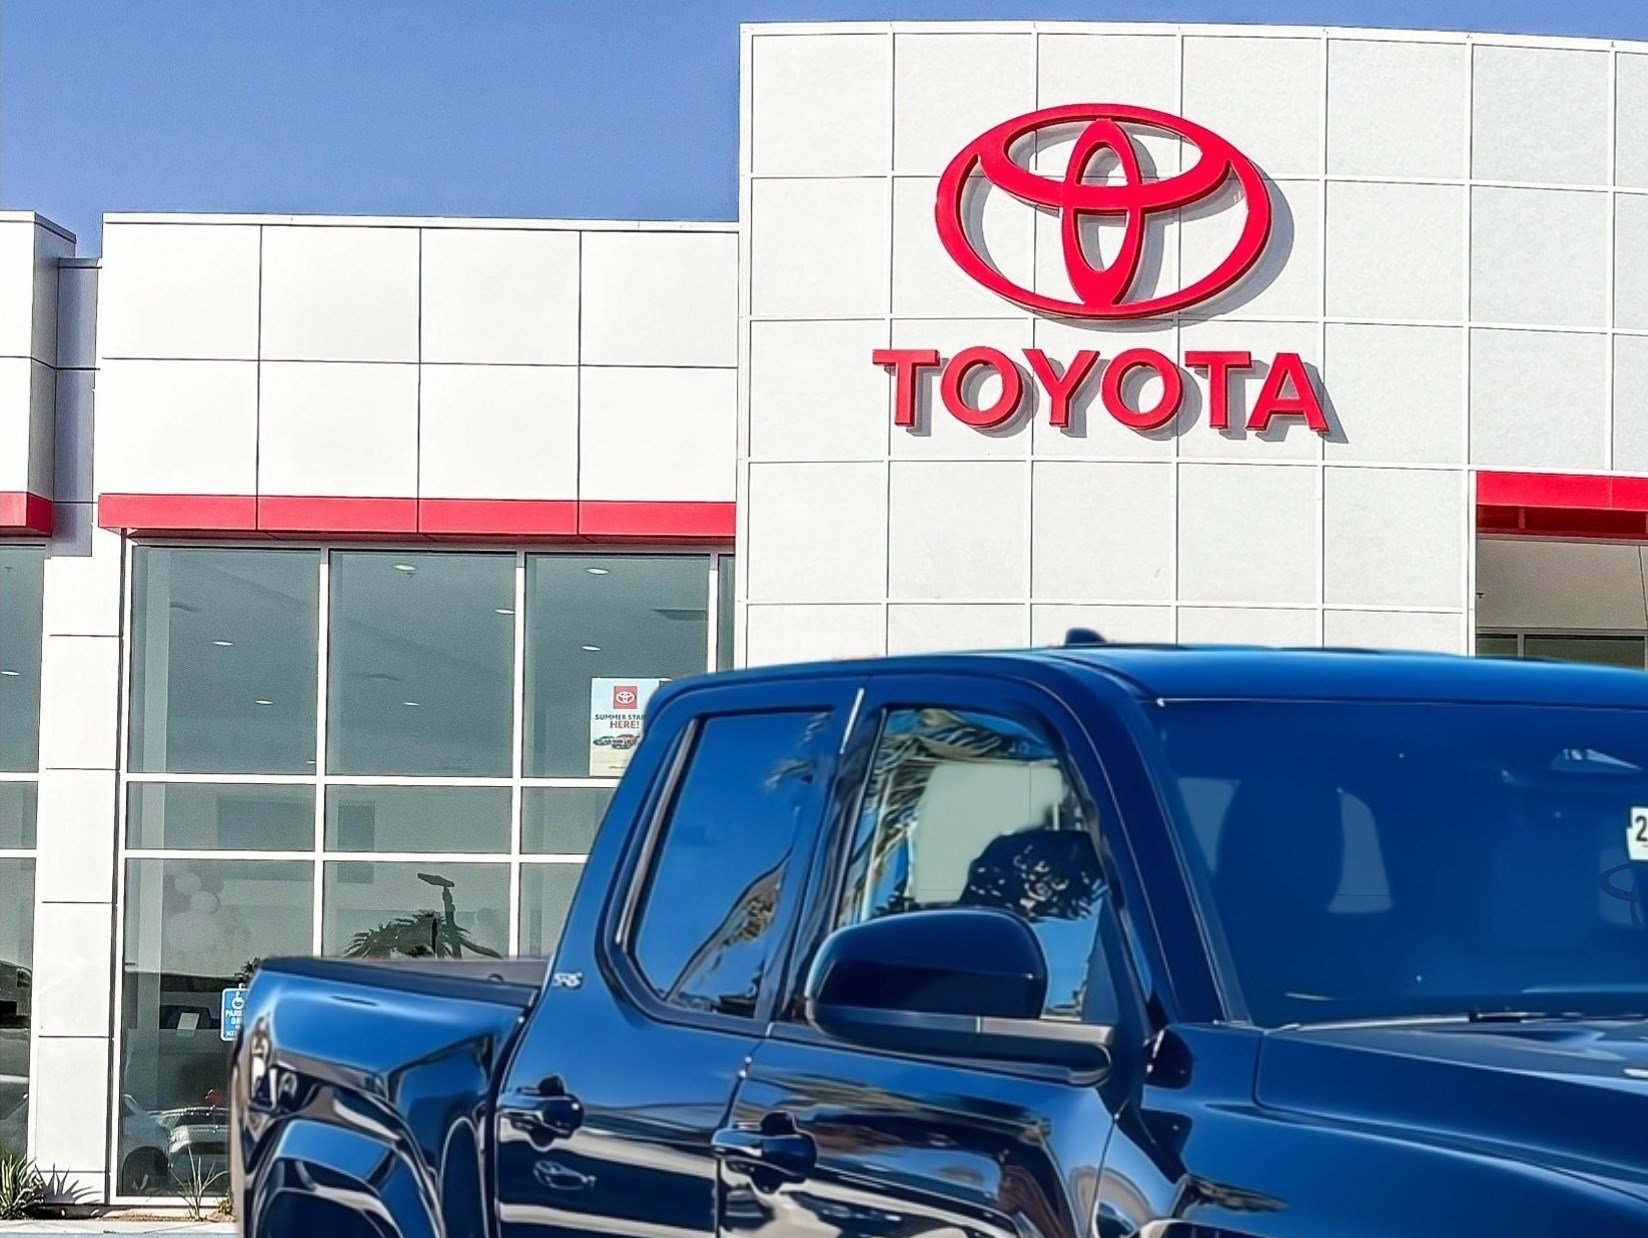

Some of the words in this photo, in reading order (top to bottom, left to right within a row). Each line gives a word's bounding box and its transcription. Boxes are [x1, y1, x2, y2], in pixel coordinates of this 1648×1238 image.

[872, 346, 1329, 432] TOYOTA
[594, 713, 627, 721] SUMMER
[609, 720, 640, 729] HERE!
